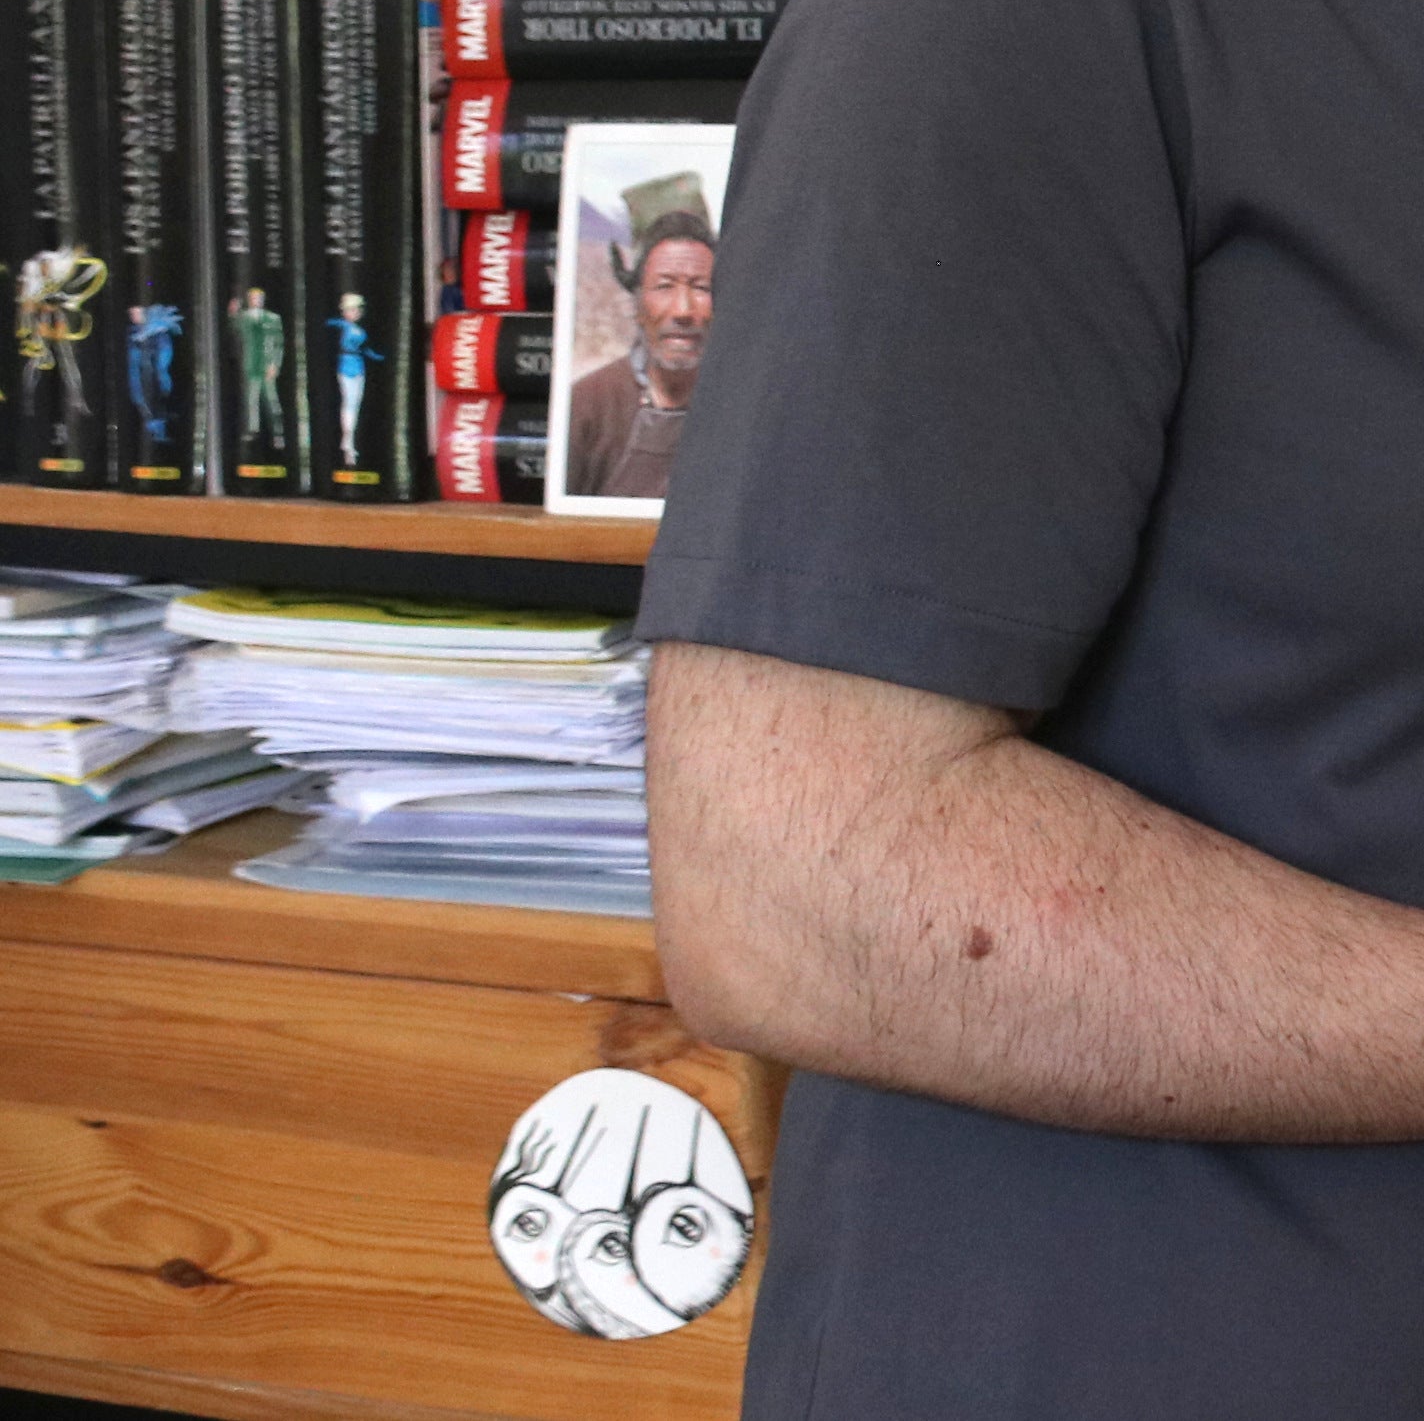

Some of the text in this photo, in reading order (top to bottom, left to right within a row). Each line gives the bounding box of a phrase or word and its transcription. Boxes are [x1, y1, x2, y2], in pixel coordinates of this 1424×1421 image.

[522, 17, 762, 42] EL PODEROSO THOR
[455, 94, 493, 194] MARVEL
[479, 211, 517, 306] MARVEL
[452, 313, 484, 390] MARVEL
[455, 397, 489, 495] MARVEL
